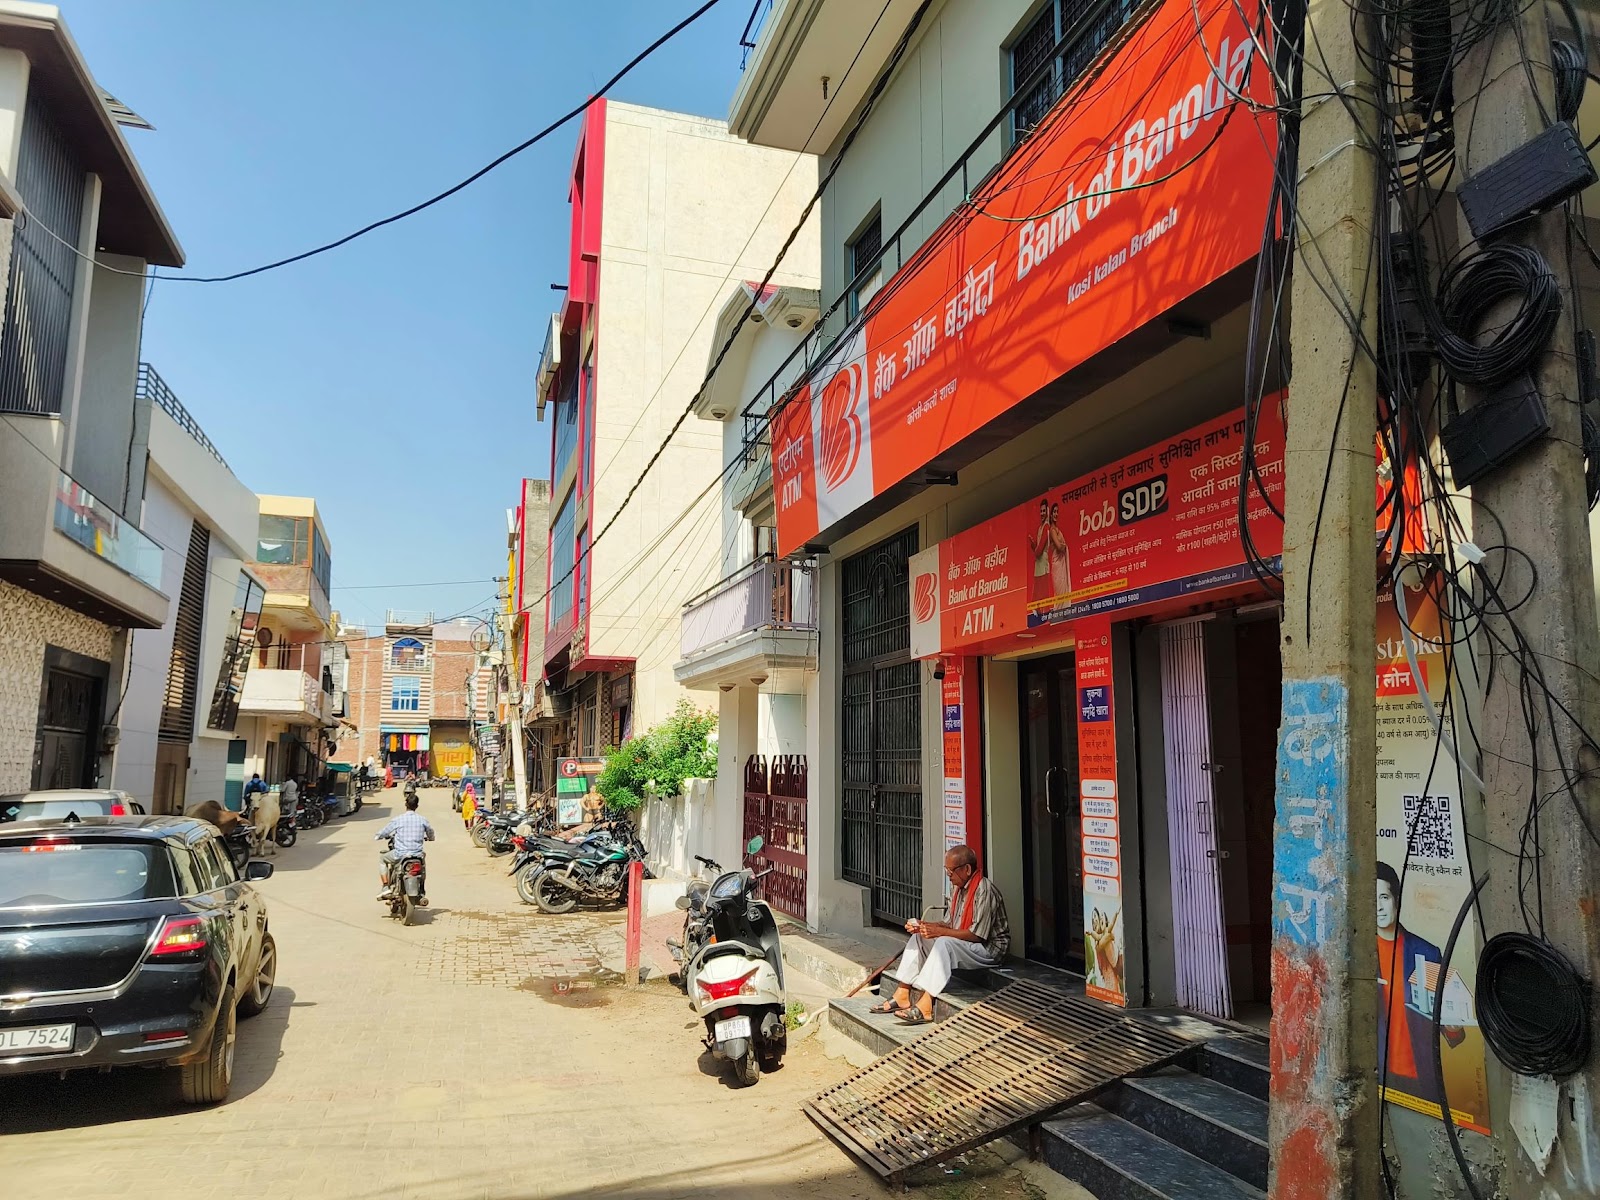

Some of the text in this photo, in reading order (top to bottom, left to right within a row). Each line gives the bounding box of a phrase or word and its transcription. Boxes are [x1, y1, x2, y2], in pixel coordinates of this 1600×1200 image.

[1017, 36, 1256, 282] Bank of Baroda
[1068, 271, 1091, 305] Kosi
[1130, 206, 1177, 258] Branch
[873, 350, 897, 400] बैंक
[945, 259, 998, 340] बड़ौदा
[939, 377, 958, 400] शाखा
[778, 434, 805, 480] एटीएम
[1061, 477, 1097, 504] समझदारी
[1100, 472, 1108, 489] से
[1110, 465, 1125, 488] चुनें
[1158, 437, 1201, 469] सुनिश्चित
[1204, 426, 1230, 447] लाभ
[1189, 463, 1208, 482] एक
[781, 471, 802, 512] ATM
[1180, 478, 1215, 504] आवर्ती
[1217, 473, 1241, 491] जमा
[1079, 480, 1166, 537] bob SDP
[1206, 501, 1220, 513] 95%
[1220, 498, 1231, 507] तक
[948, 561, 960, 581] बैंक
[984, 544, 1008, 571] बड़ौदा
[1133, 562, 1140, 571] 10
[948, 572, 1008, 606] Bank of Baroda
[1376, 591, 1393, 603] roda
[961, 604, 995, 637] ATM
[1382, 667, 1411, 688] लोन
[1086, 688, 1103, 703] सुकन्या
[1096, 705, 1109, 716] खाता
[1384, 702, 1391, 711] के
[1392, 703, 1404, 711] साथ
[1376, 731, 1385, 740] 40
[1386, 729, 1395, 738] वर्ष
[1396, 728, 1402, 738] से
[1414, 728, 1430, 740] आयु)
[1395, 770, 1403, 779] की
[1404, 772, 1420, 780] गणना
[1376, 828, 1397, 838] oan
[1425, 863, 1435, 876] हेतु
[1435, 864, 1451, 875] स्कैन
[1452, 866, 1463, 876] करें
[27, 1027, 70, 1046] 7524
